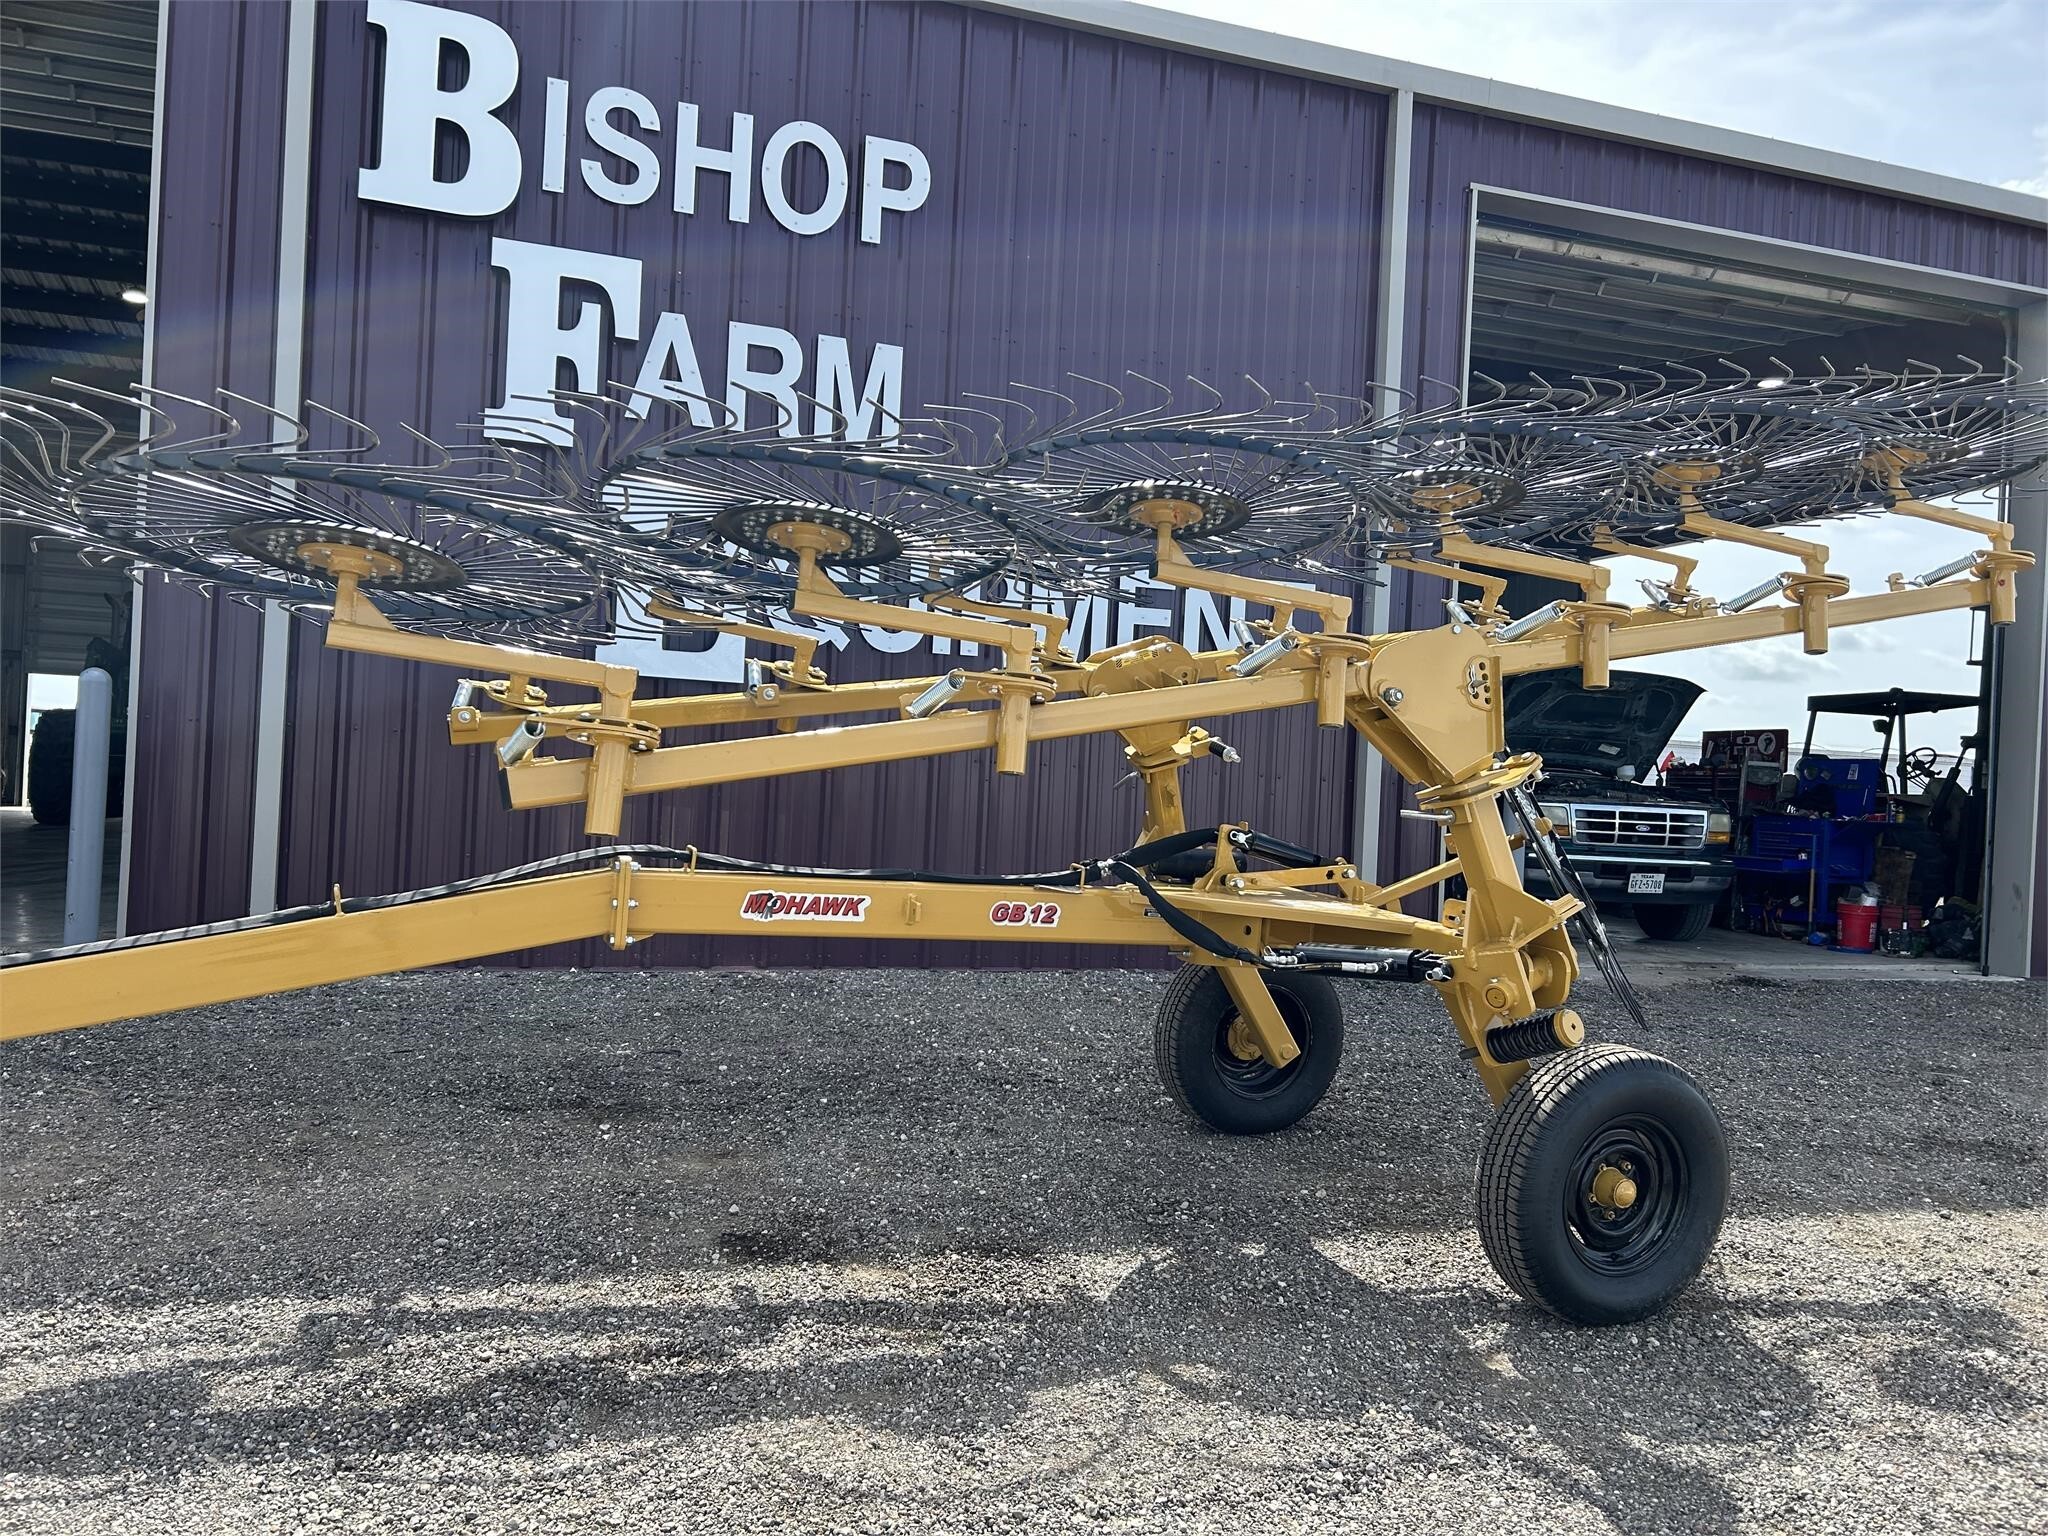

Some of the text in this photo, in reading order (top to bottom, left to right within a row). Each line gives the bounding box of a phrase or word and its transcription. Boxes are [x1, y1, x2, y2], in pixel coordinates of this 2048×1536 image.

[358, 0, 931, 244] BISHOP
[484, 237, 903, 448] FARM
[743, 894, 865, 917] MOHAWK
